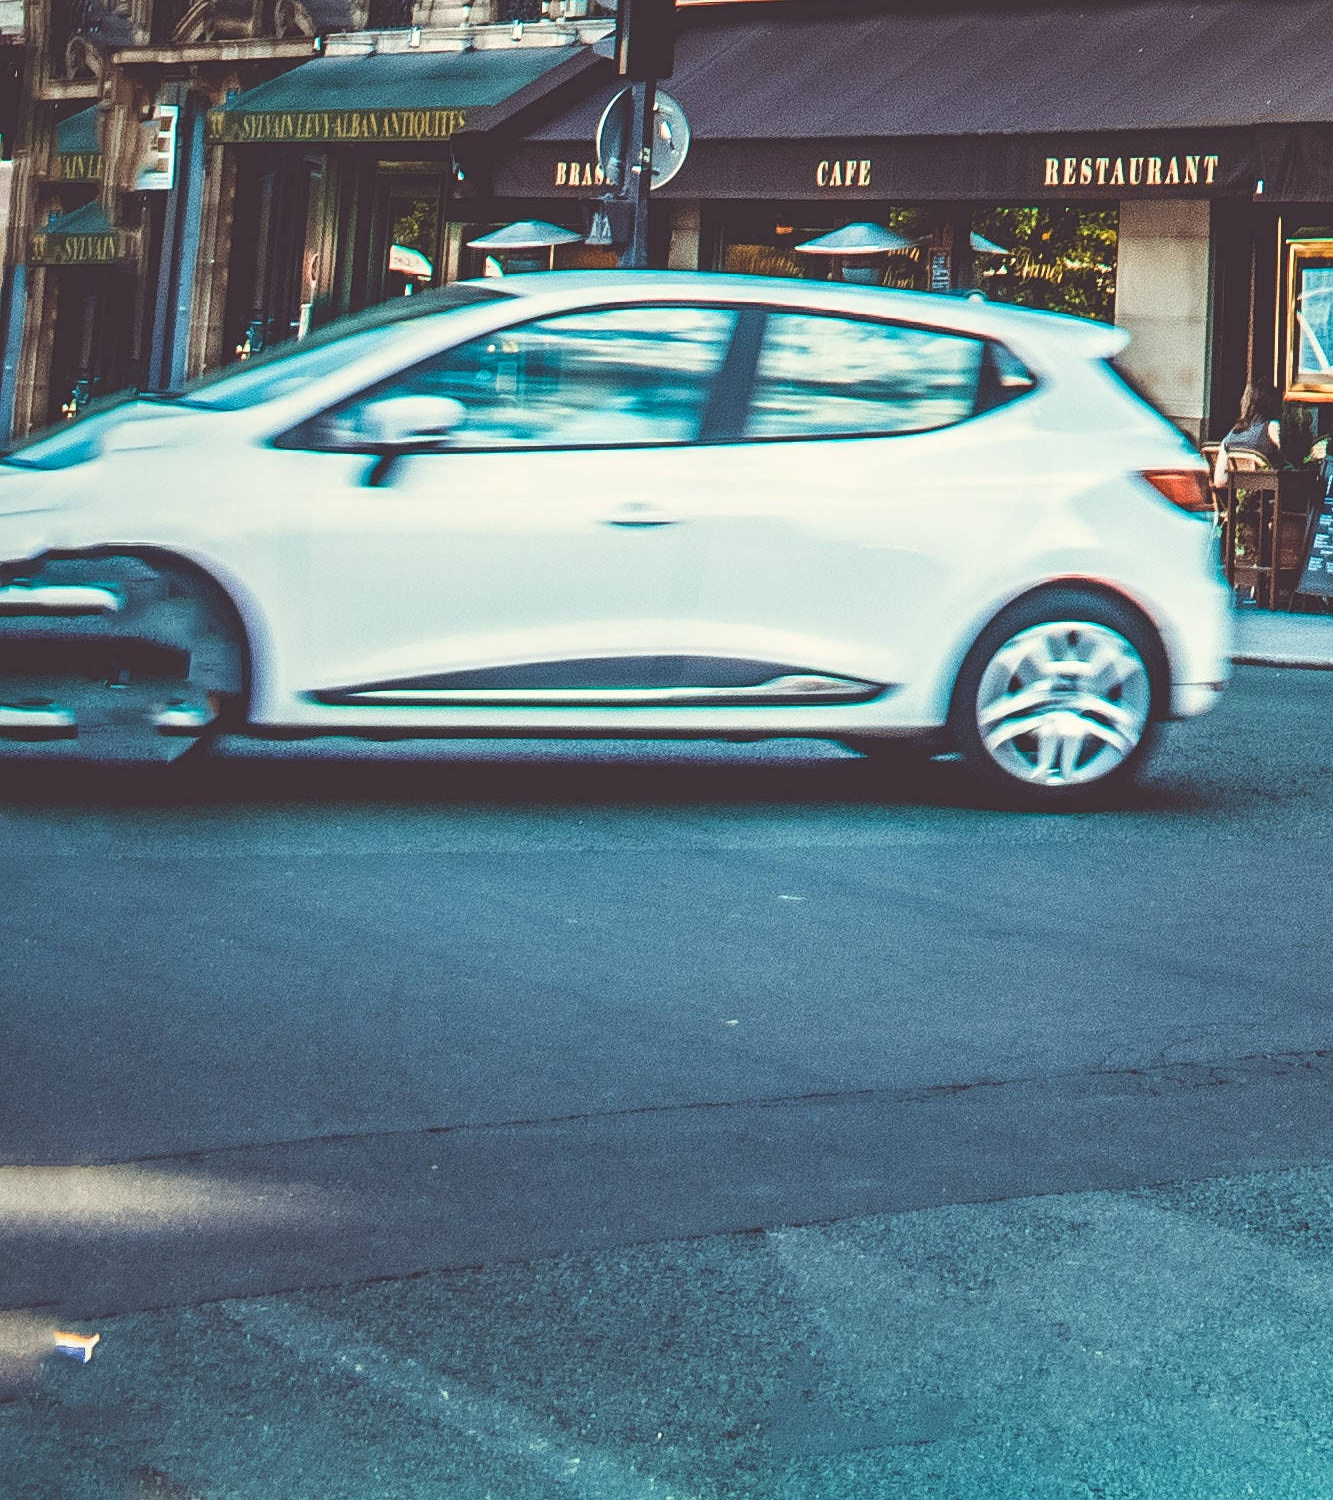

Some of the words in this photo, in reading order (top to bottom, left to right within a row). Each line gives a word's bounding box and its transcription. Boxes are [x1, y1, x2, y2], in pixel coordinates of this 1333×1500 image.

[555, 161, 613, 186] BRAS
[816, 160, 872, 187] CAFE
[1043, 155, 1219, 186] RESTAURANT
